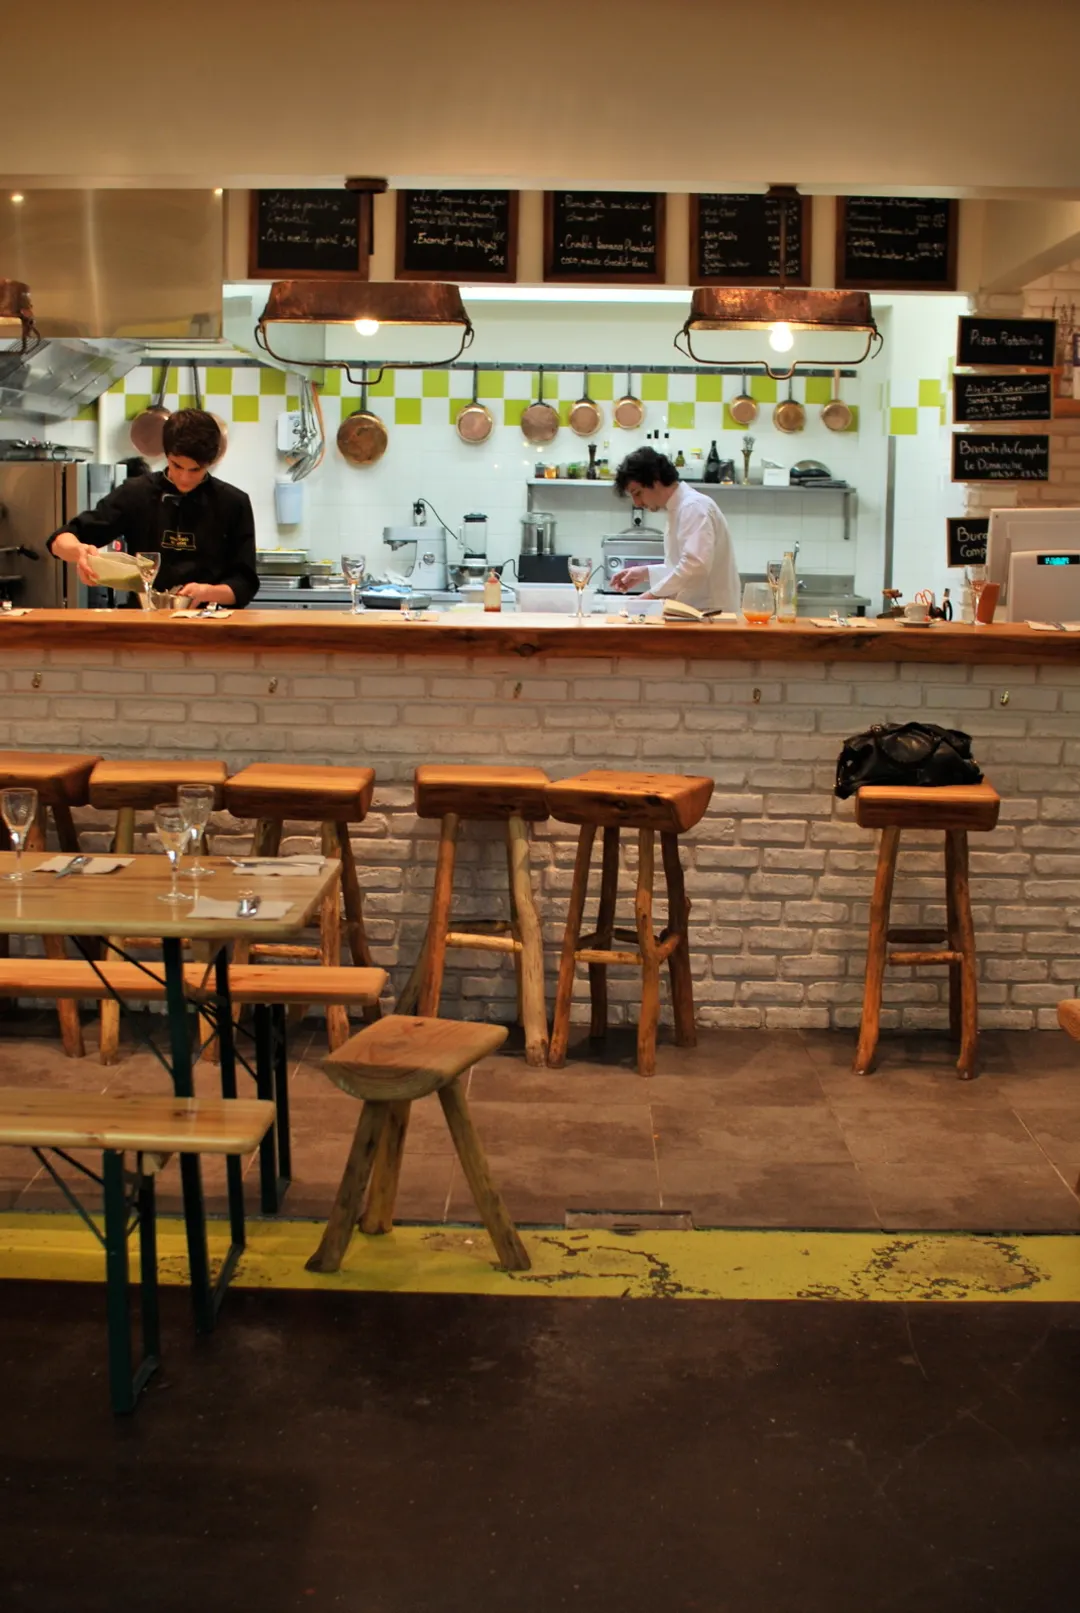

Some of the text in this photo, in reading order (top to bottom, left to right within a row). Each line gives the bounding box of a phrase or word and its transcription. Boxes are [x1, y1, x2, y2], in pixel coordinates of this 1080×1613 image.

[970, 328, 998, 346] Pizza
[959, 440, 999, 455] Brunch
[1000, 442, 1013, 455] du
